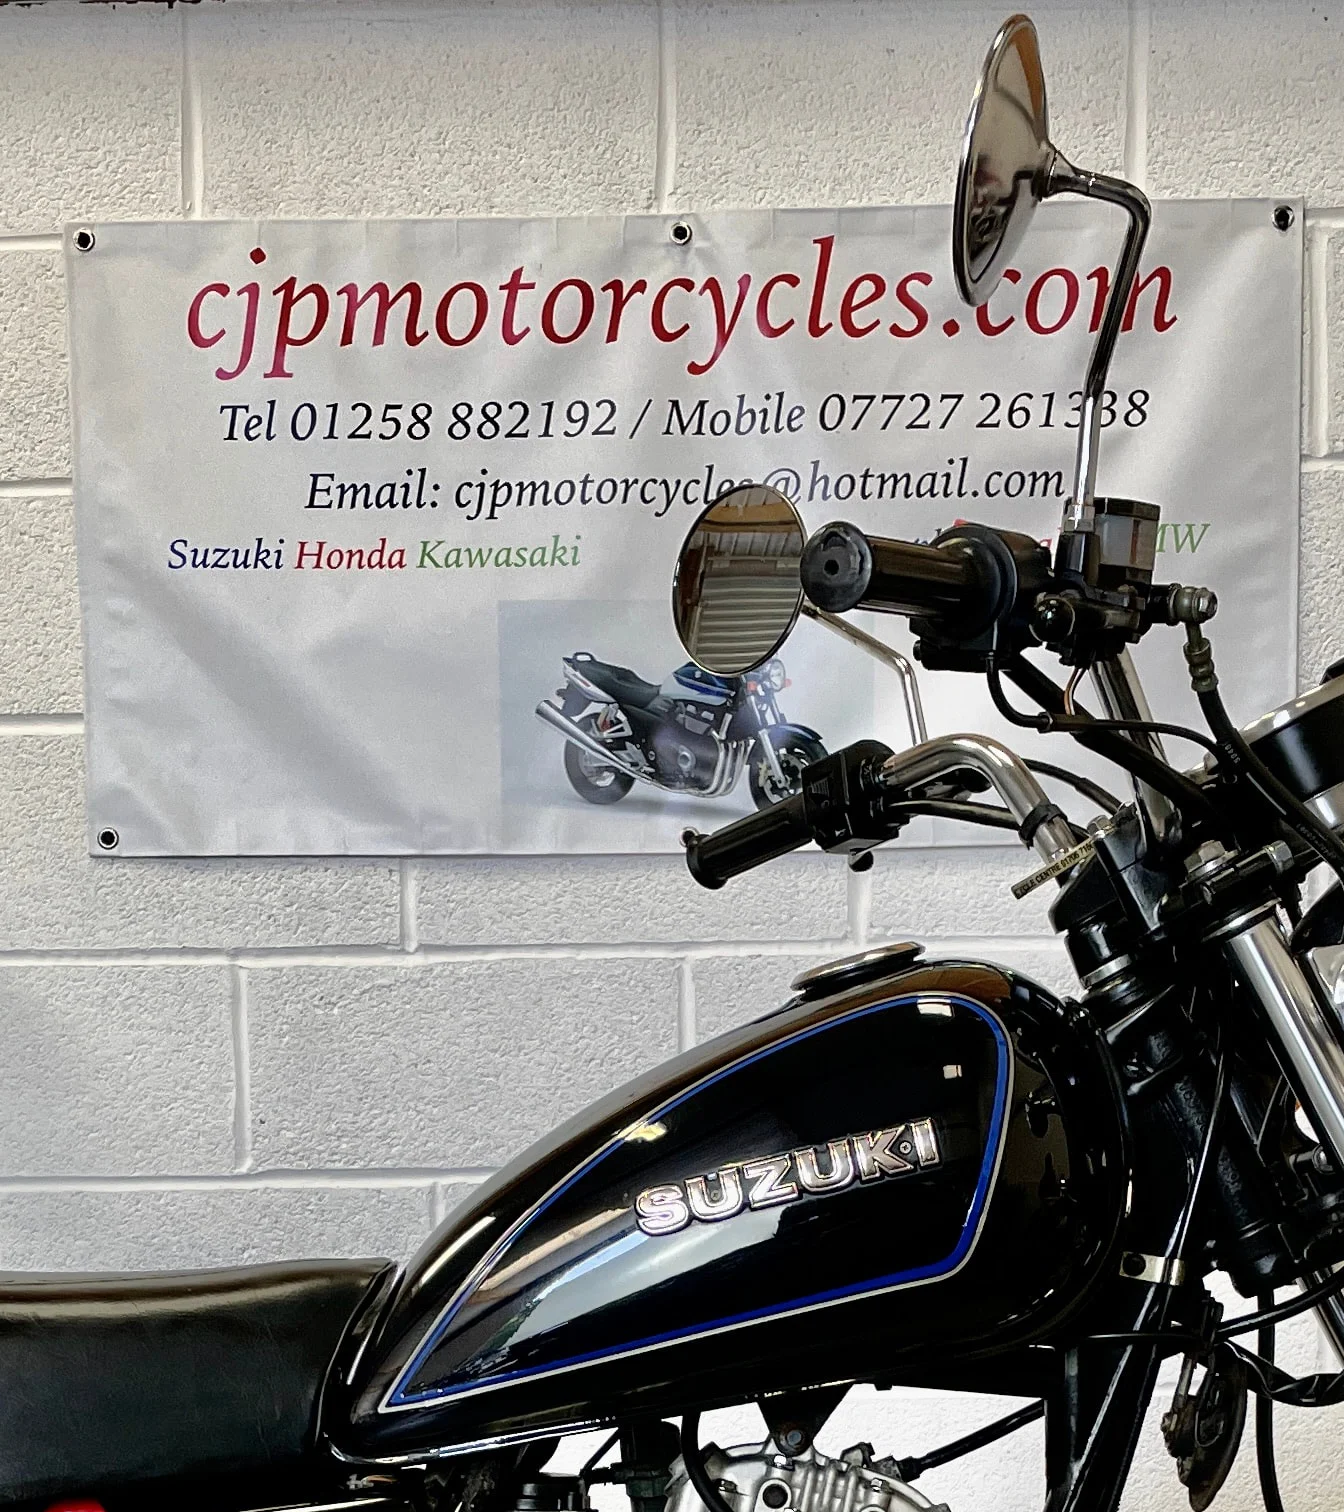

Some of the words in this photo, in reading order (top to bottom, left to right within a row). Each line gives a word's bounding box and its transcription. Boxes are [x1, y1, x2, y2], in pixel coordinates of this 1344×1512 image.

[186, 235, 1178, 381] cjpmotorcycles.com
[219, 404, 276, 441] Tel
[290, 401, 433, 440] 01258
[447, 399, 618, 440] 882192
[629, 398, 653, 439] /
[662, 391, 805, 436] Mobile
[818, 391, 963, 431] 07727
[304, 467, 440, 510] Email:
[455, 456, 1066, 521] cjpmotorcycle@hotmail.com
[167, 537, 285, 570] Suzuki
[294, 537, 407, 570] Honda
[416, 534, 581, 569] Kawasaki
[1035, 863, 1061, 882] CENTRE
[635, 1116, 943, 1237] SUZUKI
